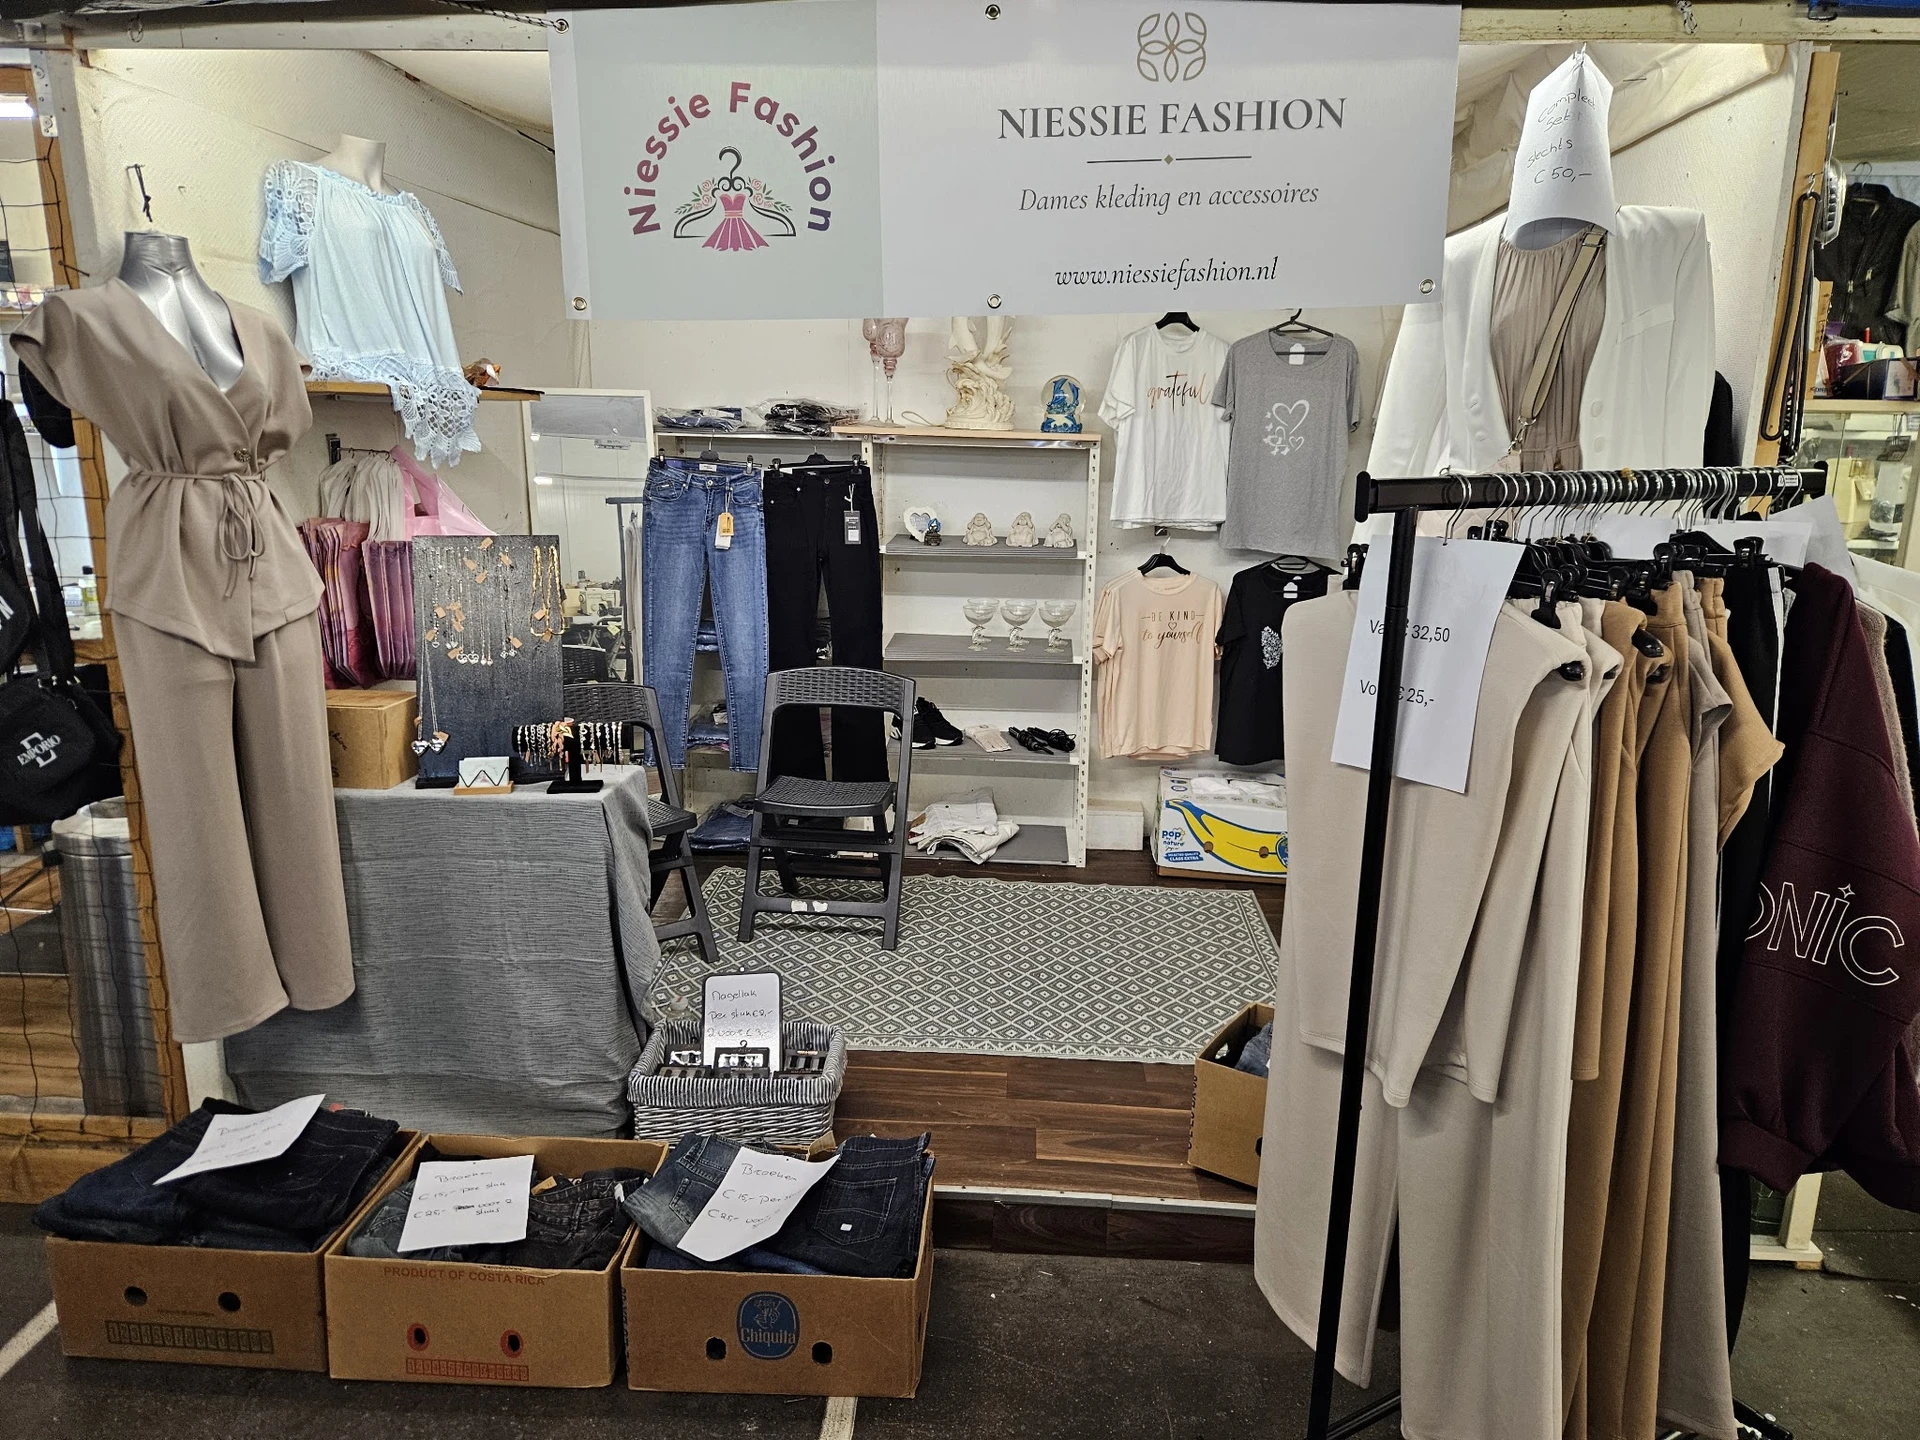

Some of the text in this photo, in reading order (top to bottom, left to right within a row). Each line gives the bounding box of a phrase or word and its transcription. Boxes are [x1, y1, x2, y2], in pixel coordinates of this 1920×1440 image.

[998, 97, 1348, 140] NIESSIE FASHION
[624, 81, 835, 235] Niessie Fashion
[1019, 182, 1319, 216] Dames kleding en accessoires
[1054, 255, 1279, 291] www.niessiefashion.nl
[1147, 370, 1211, 414] grateful
[1169, 610, 1196, 621] KIND
[1142, 620, 1204, 649] to yourself
[1411, 624, 1450, 643] 32,50
[17, 734, 61, 766] EMPORIO
[1161, 830, 1181, 840] pop
[383, 1266, 546, 1286] PRODUCT OF COSTA RICA
[740, 1327, 796, 1347] Chiquita
